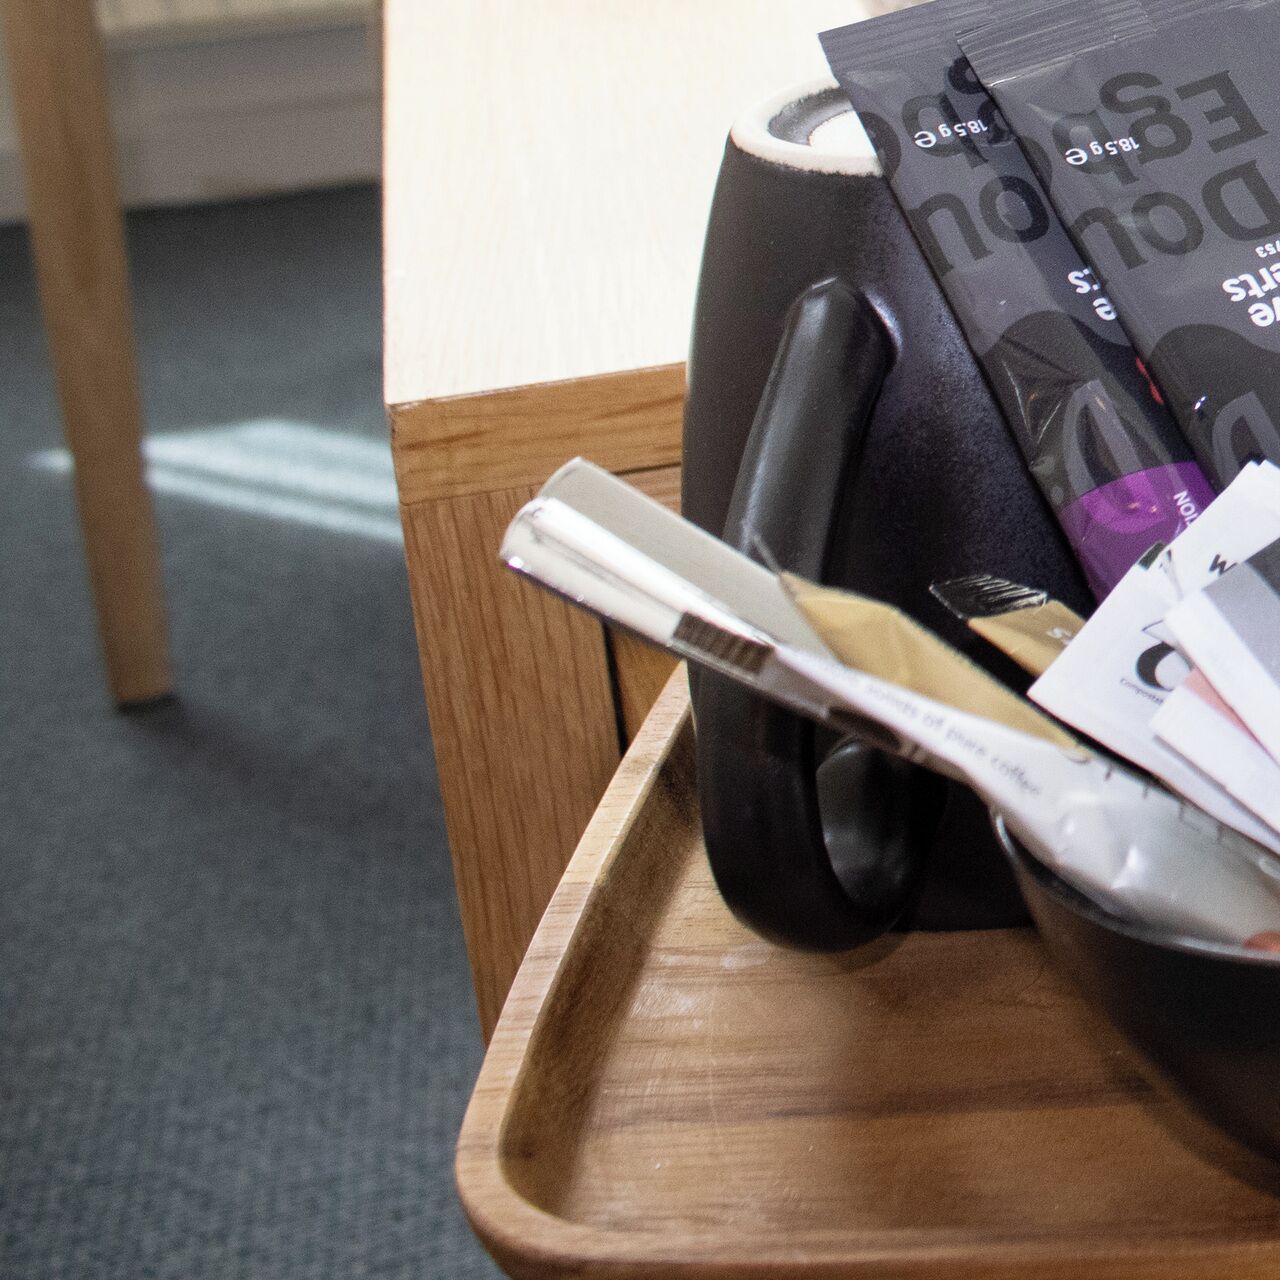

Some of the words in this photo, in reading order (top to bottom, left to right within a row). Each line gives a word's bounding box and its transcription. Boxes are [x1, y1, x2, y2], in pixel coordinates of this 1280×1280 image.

[938, 123, 952, 138] g
[953, 119, 988, 138] 18.5
[1089, 140, 1103, 157] g
[1105, 136, 1140, 157] 18.5
